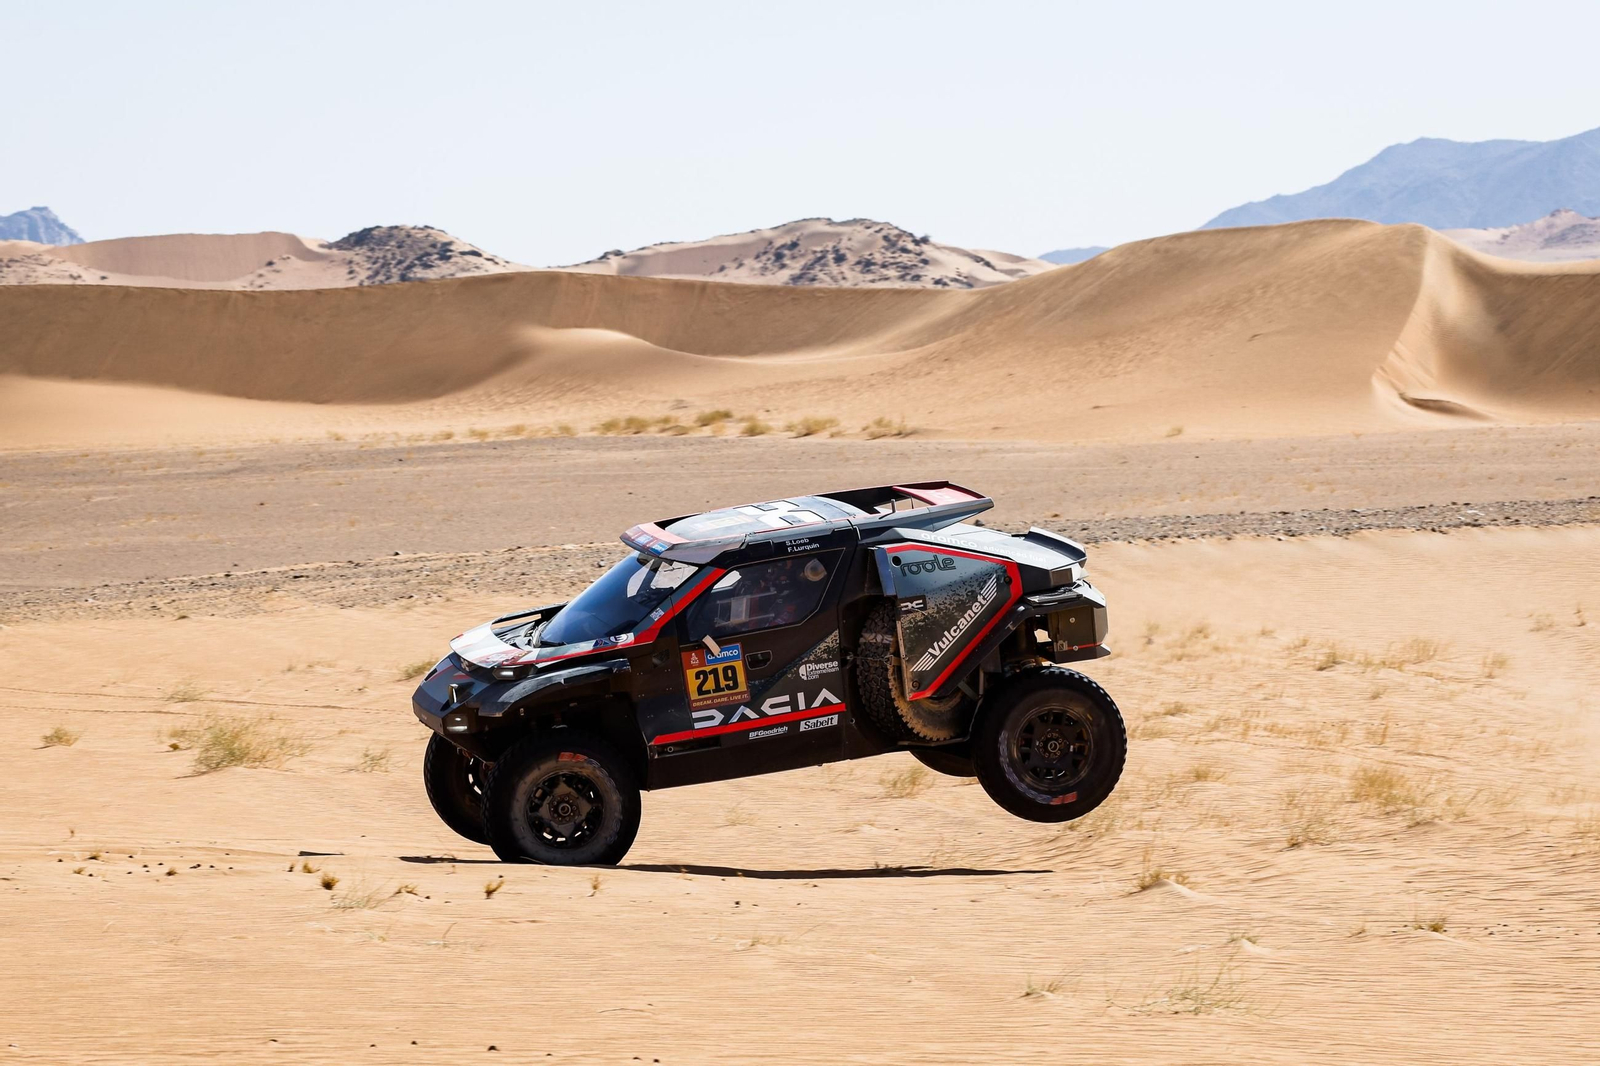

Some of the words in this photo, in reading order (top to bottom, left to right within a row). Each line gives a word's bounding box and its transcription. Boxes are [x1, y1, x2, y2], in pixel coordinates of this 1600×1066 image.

[921, 533, 977, 548] aramco
[787, 543, 820, 553] F.Lurquin
[927, 594, 987, 656] Vulcanet
[707, 649, 739, 660] aamco
[807, 661, 838, 671] Diverse
[695, 665, 739, 696] 219
[692, 688, 841, 729] DACIA
[804, 717, 834, 729] Sabelt
[749, 726, 788, 738] BFGoodrich
